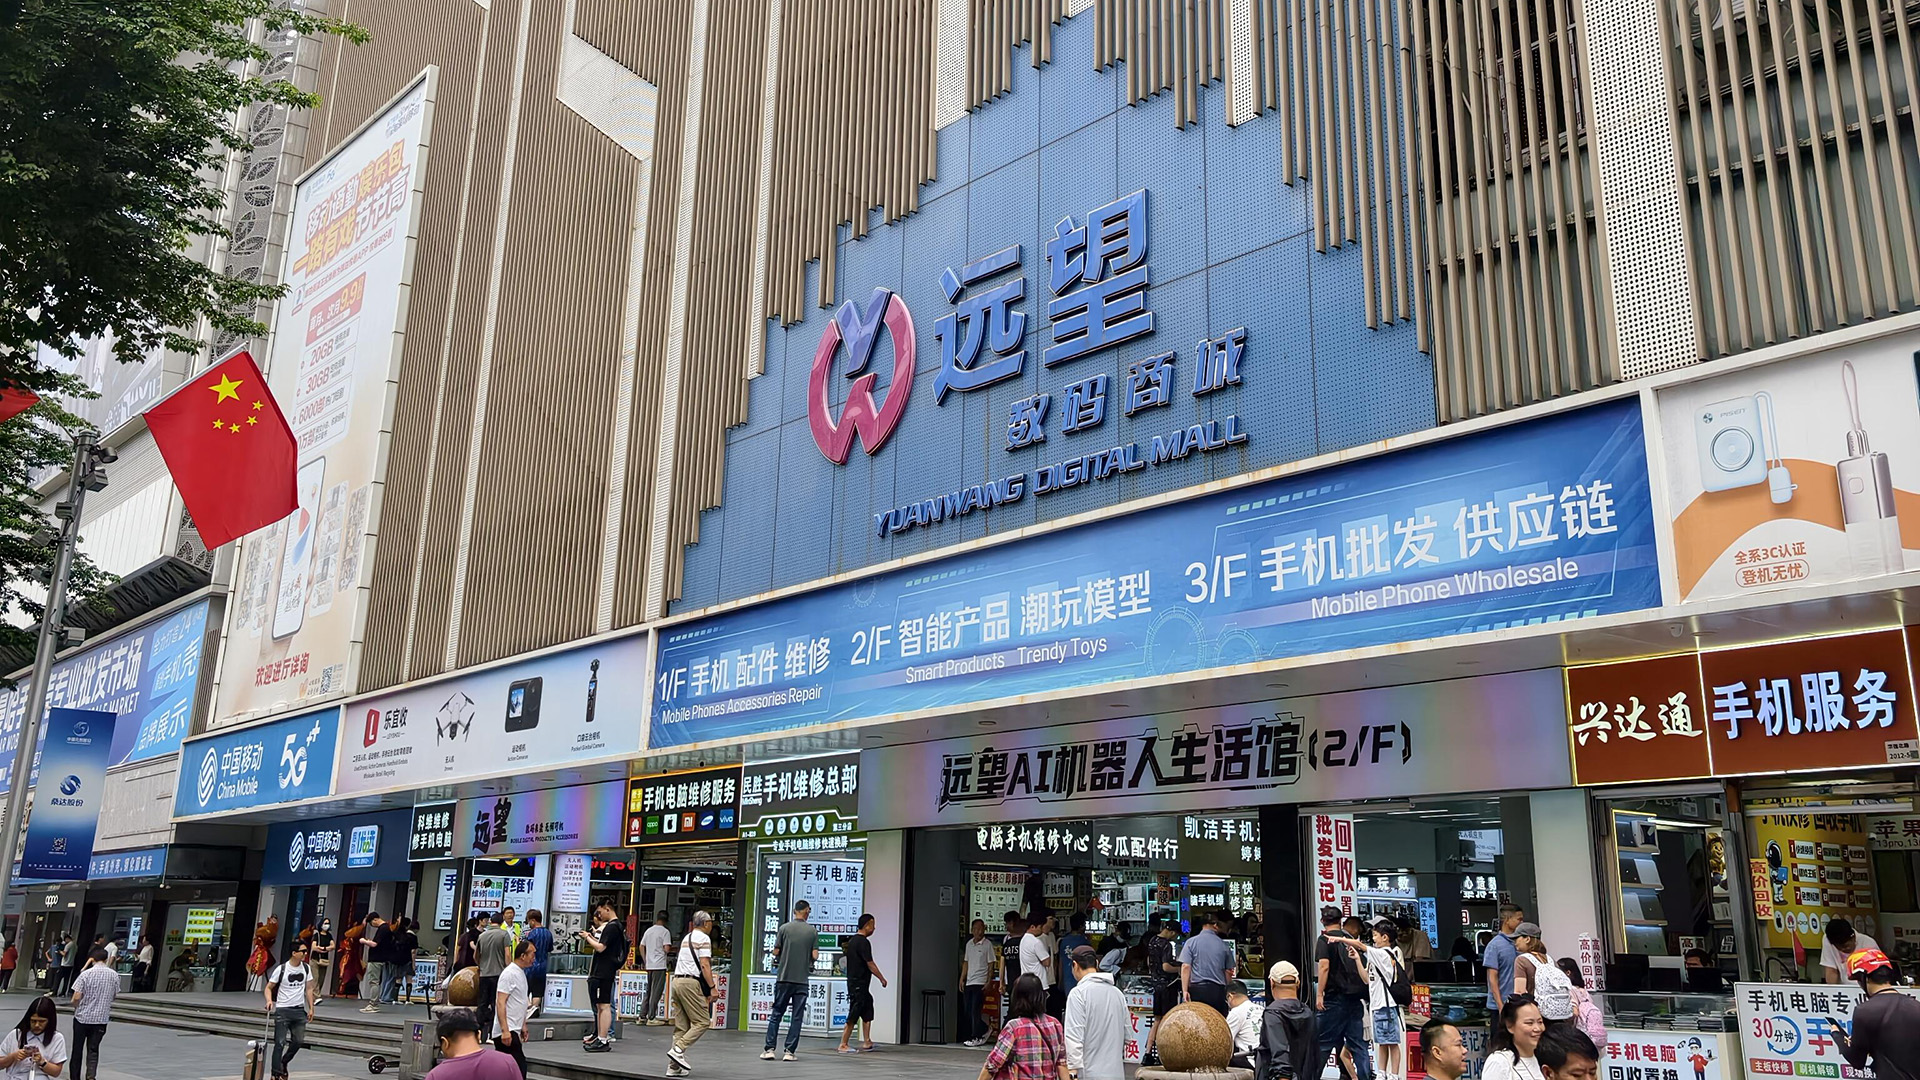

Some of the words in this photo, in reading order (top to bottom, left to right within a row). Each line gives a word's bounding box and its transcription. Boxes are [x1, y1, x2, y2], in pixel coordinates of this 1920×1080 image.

[293, 164, 411, 279] 一路有戏节节高
[932, 188, 1156, 406] 远望
[1005, 326, 1248, 451] 数码商城
[874, 473, 1026, 538] YUANWANG
[1033, 442, 1146, 496] DIGITAL
[1149, 415, 1248, 466] MALL
[1184, 552, 1247, 604] 3/F
[1259, 515, 1440, 593] 手机批发
[1453, 479, 1618, 559] 供应链
[1734, 541, 1807, 566] 全系3C认证
[1311, 591, 1377, 619] Mobile
[1382, 582, 1450, 607] Phone
[1454, 557, 1579, 595] Wholesale
[1742, 563, 1804, 586] 登机无忧
[851, 624, 892, 666] 2/F
[898, 600, 1011, 658] 智能产品
[1020, 570, 1151, 636] 潮玩模型
[254, 652, 310, 688] 欢迎进厅详询
[658, 667, 687, 702] 1/F
[690, 653, 730, 697] 手机
[736, 647, 778, 688] 配件
[784, 637, 831, 679] 维修
[905, 662, 943, 684] Smart
[946, 652, 1005, 677] Products
[1017, 642, 1067, 664] Trendy
[1072, 635, 1107, 659] Toys
[383, 706, 409, 731] 乐宜收
[662, 707, 690, 725] Mobile
[692, 704, 725, 720] Phones
[727, 690, 787, 714] Accessories
[788, 684, 823, 705] Repair
[1573, 691, 1704, 746] 兴达通
[1712, 668, 1896, 740] 手机服务
[138, 697, 188, 752] 品牌展示
[221, 741, 264, 778] 中国移动
[217, 780, 235, 800] China
[235, 775, 259, 798] Mobile
[643, 777, 736, 812] 手机电脑维修服务
[763, 764, 857, 803] 手机维修总部
[307, 829, 342, 854] 中国移动
[473, 797, 512, 854] 远望
[976, 825, 1090, 855] 电脑手机维修中心
[1184, 815, 1260, 842] 凯洁手机
[304, 856, 318, 871] China
[318, 854, 338, 869] Mobile
[1097, 834, 1179, 860] 冬瓜配件行
[1751, 861, 1772, 917] 高价回收
[1579, 938, 1594, 990] 高价回收
[1592, 937, 1606, 990] 高价回收
[714, 975, 728, 1027] 快速换屏
[1607, 1042, 1677, 1063] 手机电脑
[1774, 1030, 1795, 1043] 分钟
[1754, 1061, 1789, 1073] 主板快修
[1800, 1062, 1836, 1076] 刷机解锁
[1845, 1066, 1876, 1079] 现场换
